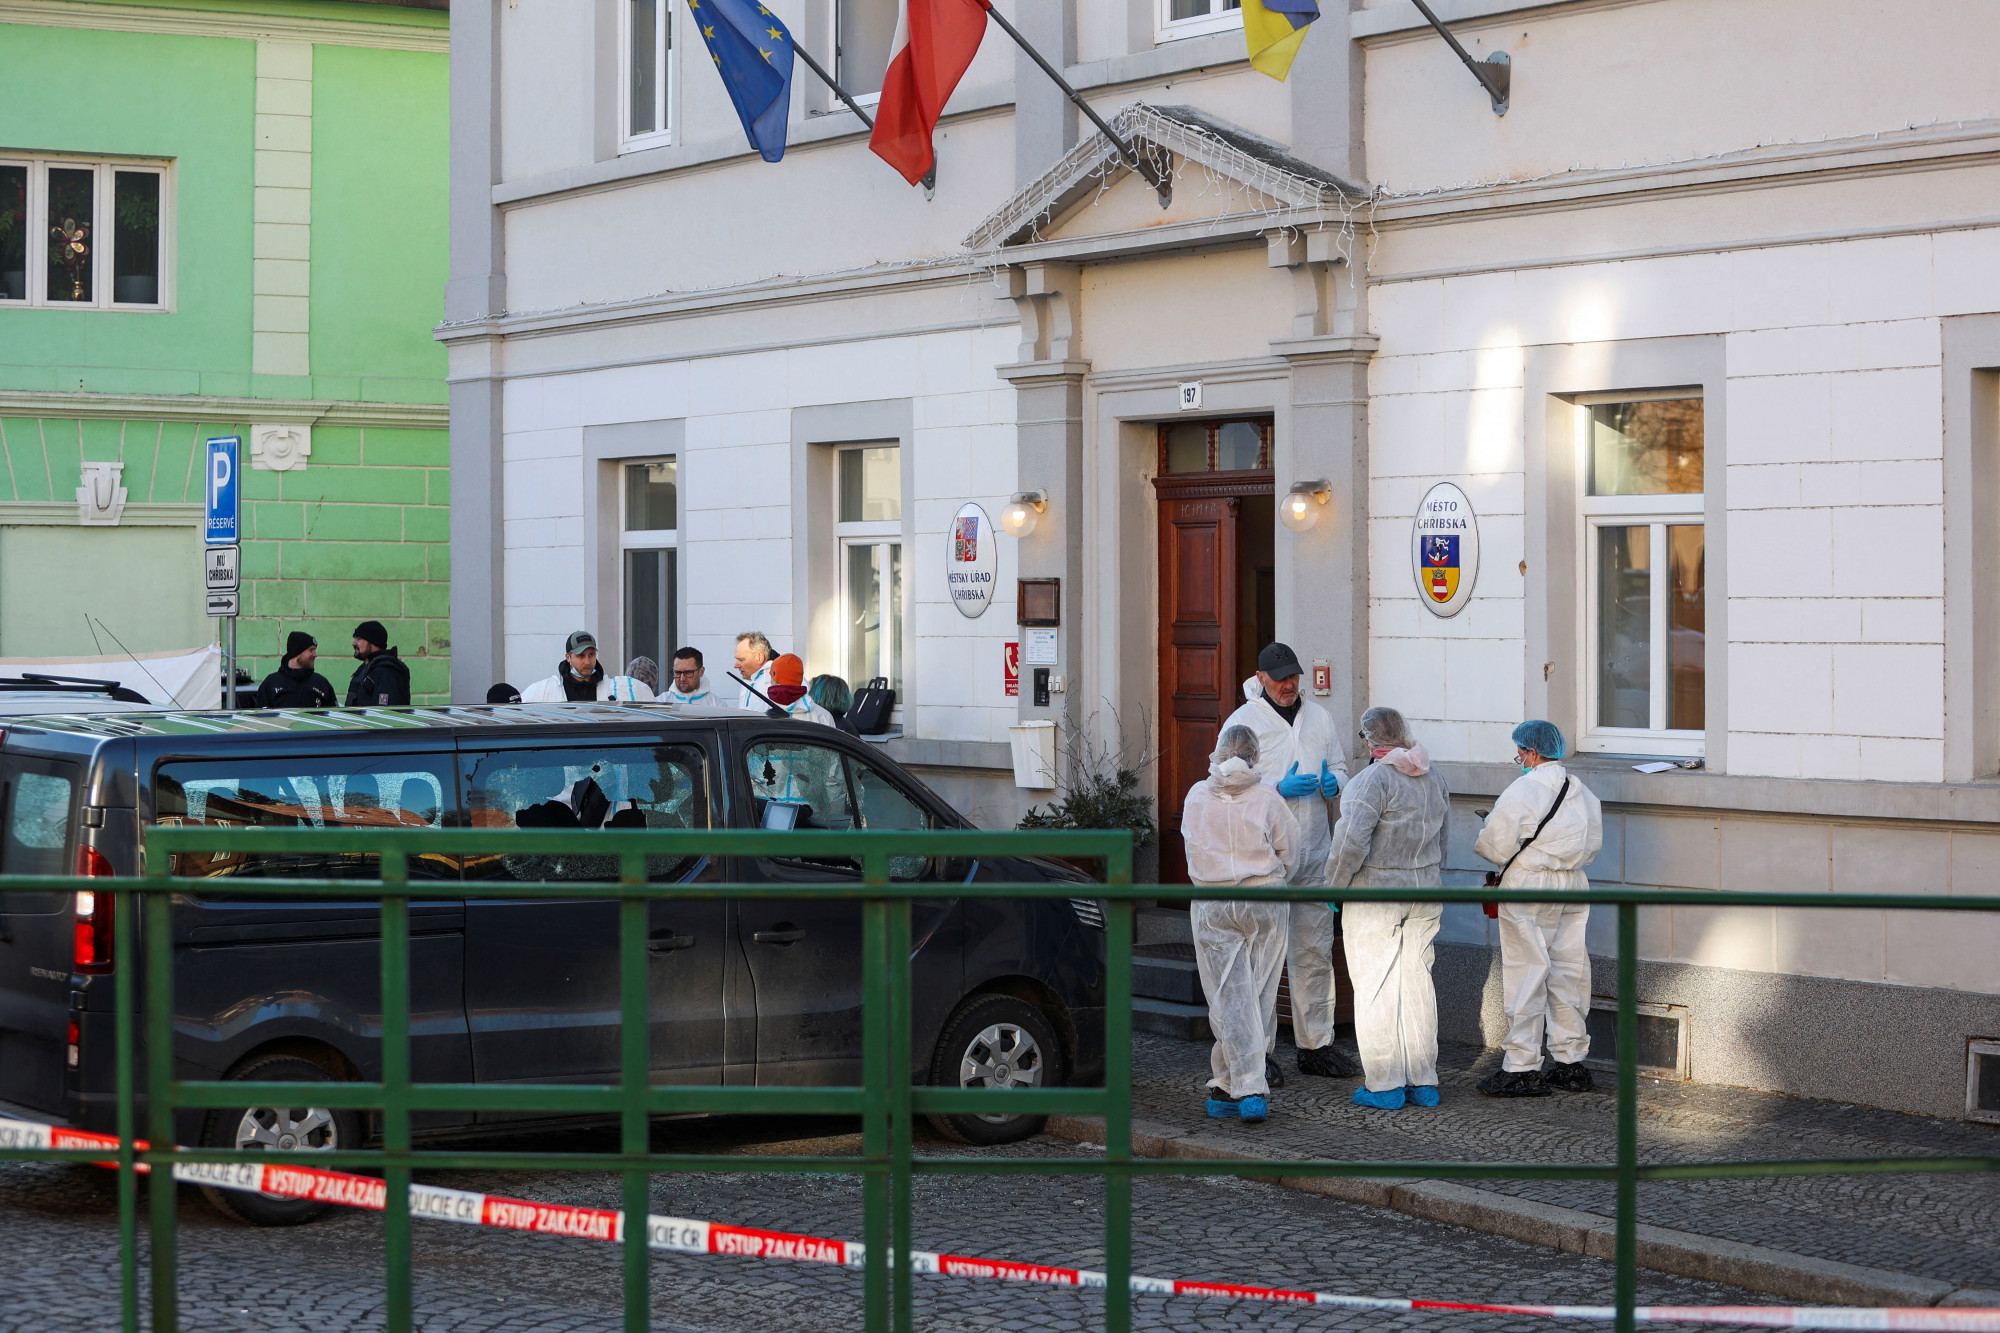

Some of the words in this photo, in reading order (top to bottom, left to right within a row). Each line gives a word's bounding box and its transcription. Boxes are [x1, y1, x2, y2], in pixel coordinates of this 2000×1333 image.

[1183, 387, 1196, 404] 197
[213, 452, 231, 509] P
[1425, 499, 1458, 512] MĚSTO
[209, 516, 235, 529] RÉSERVÉ
[1417, 516, 1467, 530] CHŘIBSKÁ
[208, 566, 234, 581] CHŘIBSKÁ
[970, 569, 991, 583] ÚŘAD
[954, 586, 985, 600] CHŘIBSKÁ
[270, 1169, 315, 1197] VSTUP
[316, 1176, 387, 1208] ZAKÁZÁN
[409, 1190, 451, 1216] OLICIE
[456, 1193, 475, 1219] ČR
[490, 1201, 536, 1228] VSTUP
[537, 1206, 610, 1238] ZAKÁZÁN
[716, 1231, 762, 1256] VSTUP
[764, 1236, 838, 1263] ZAKÁZÁN
[945, 1260, 994, 1278] VSTUP
